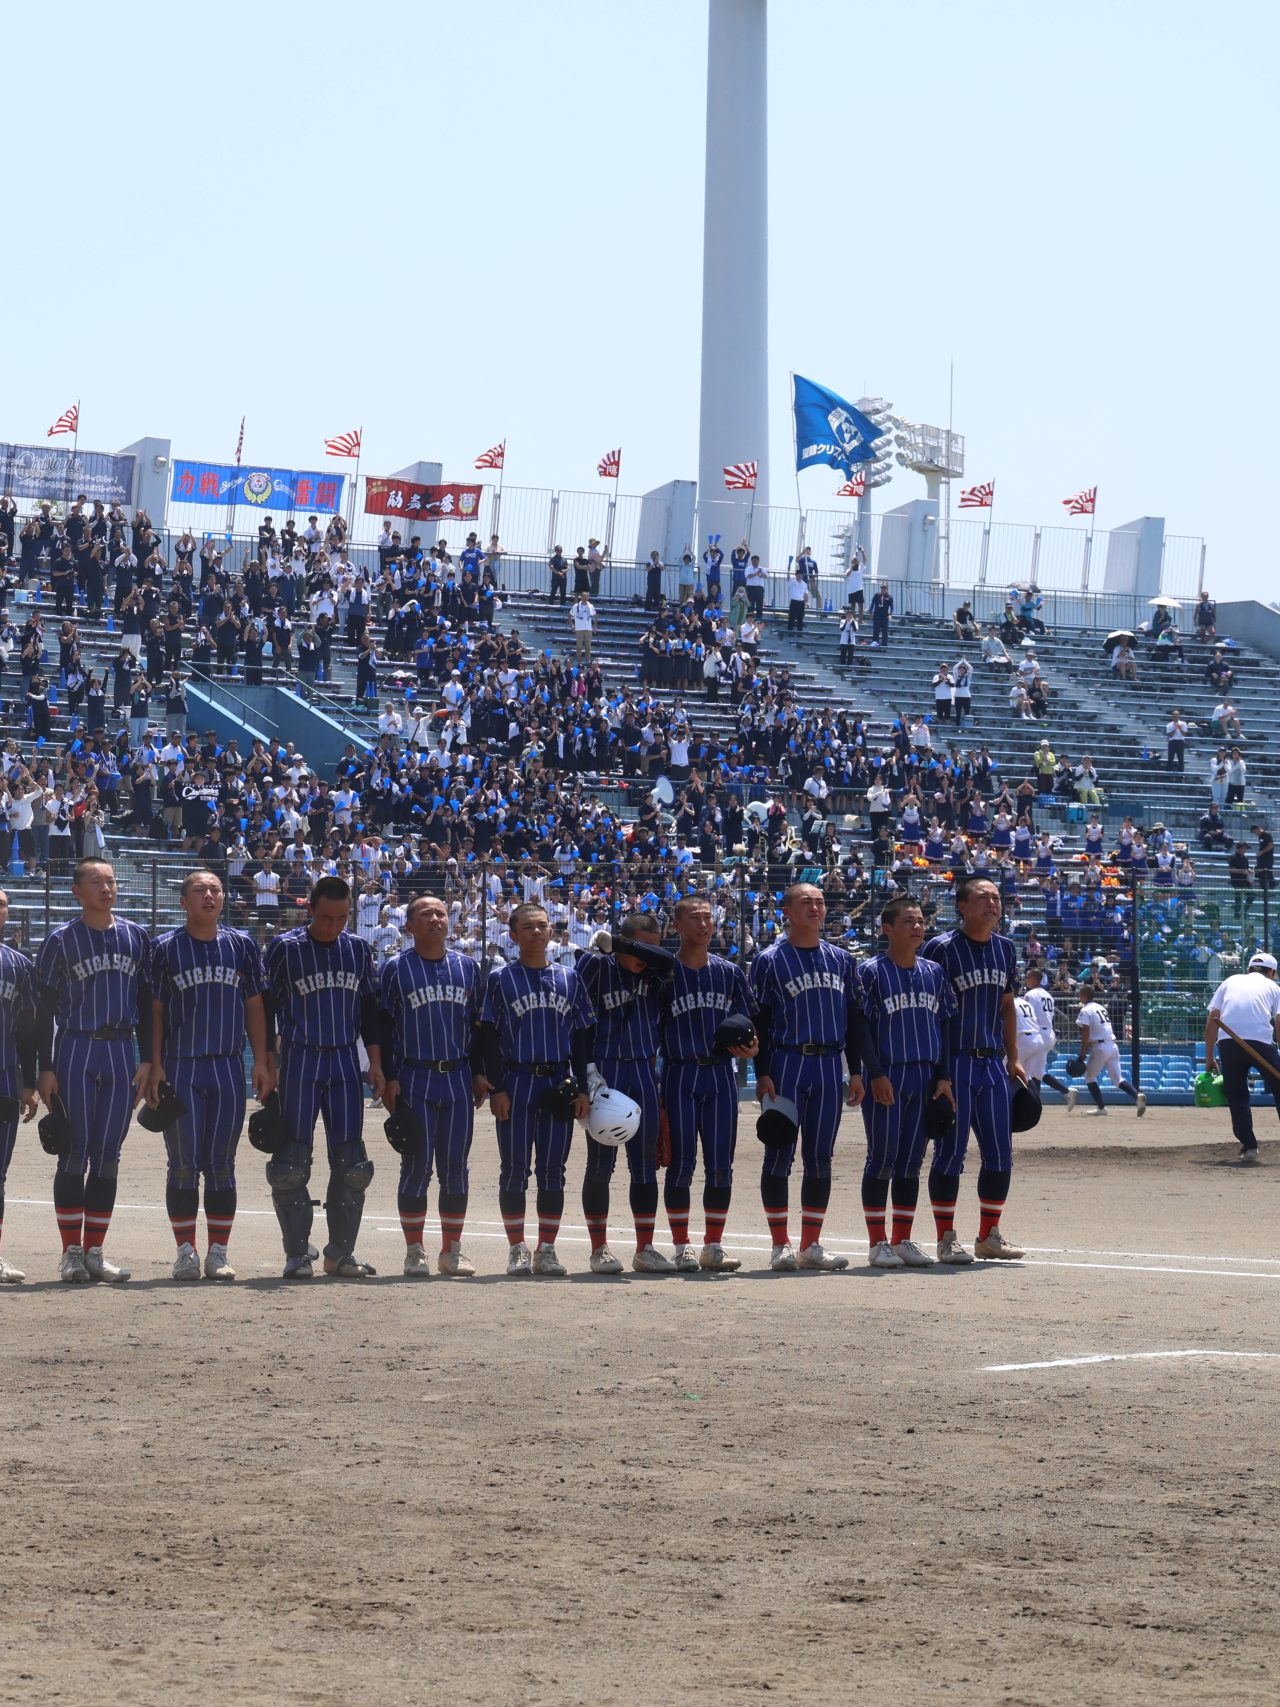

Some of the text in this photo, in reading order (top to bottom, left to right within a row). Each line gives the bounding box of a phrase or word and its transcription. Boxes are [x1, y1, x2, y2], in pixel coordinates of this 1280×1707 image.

[176, 470, 220, 498] 力戦
[296, 479, 337, 507] 奮闘
[72, 953, 136, 981] HIGASHI
[172, 966, 240, 991] HIGASHI
[954, 966, 1008, 993] HIGASH
[294, 970, 360, 996] HIGASHI
[784, 971, 846, 998] HIGASHI
[510, 991, 571, 1019] HIGASHI
[671, 991, 733, 1017] HIGASHI
[883, 991, 940, 1015] HIGASHI
[1019, 1004, 1033, 1018] 17
[1041, 997, 1053, 1012] 20
